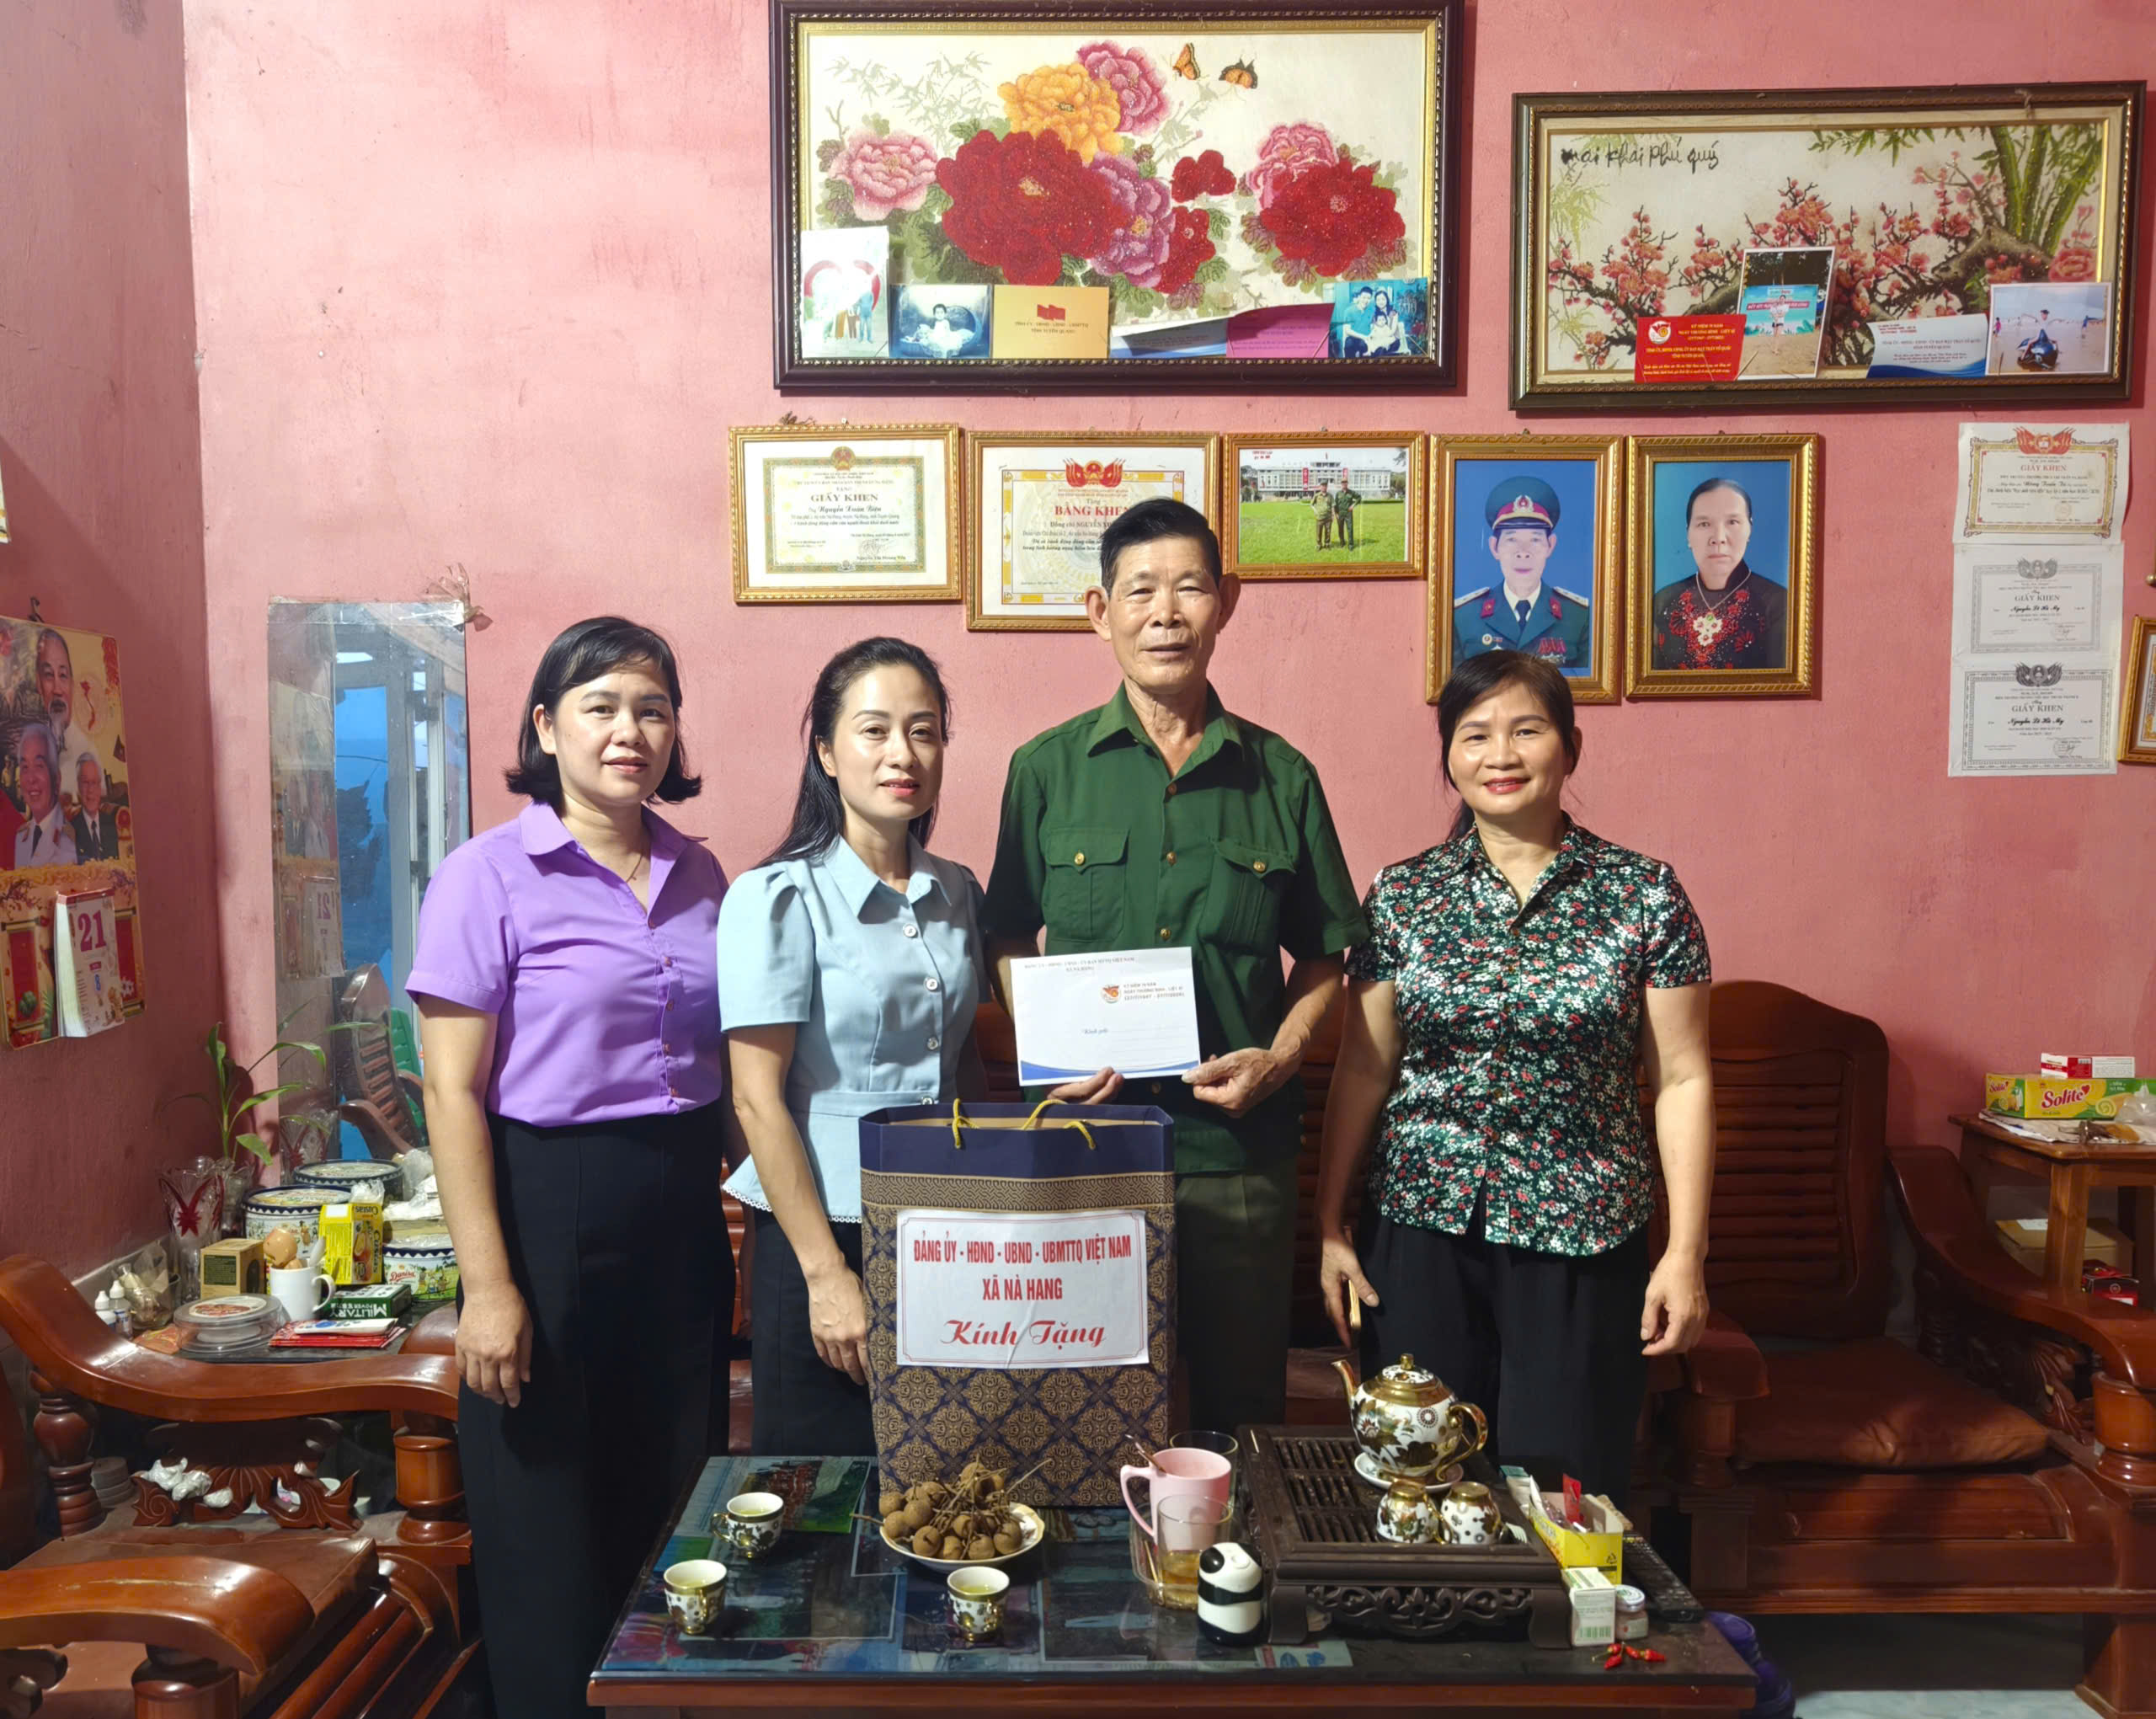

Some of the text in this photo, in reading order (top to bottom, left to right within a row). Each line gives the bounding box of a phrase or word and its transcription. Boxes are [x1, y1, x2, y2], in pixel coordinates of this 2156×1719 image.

[811, 492, 878, 502] GIẤY KHEN
[1054, 501, 1129, 516] BẰNG KHE
[2015, 592, 2035, 601] GIẤY
[2011, 702, 2035, 713] GIẤY
[77, 910, 107, 952] 21
[1989, 1082, 2006, 1092] Solite
[2041, 1088, 2084, 1109] Solite
[914, 1231, 941, 1263] ĐẢNG
[944, 1231, 957, 1263] ỦY
[967, 1241, 994, 1263] HĐND
[1005, 1241, 1033, 1264] UBND
[1043, 1240, 1082, 1264] UBMTTQ
[1086, 1233, 1106, 1265] VIỆT
[1108, 1235, 1131, 1258] NAM
[390, 1271, 416, 1282] Danisa
[983, 1274, 1063, 1300] XÃ NÀ HANG
[330, 1303, 387, 1317] MILITARY
[940, 1319, 1106, 1350] Kính Tặng
